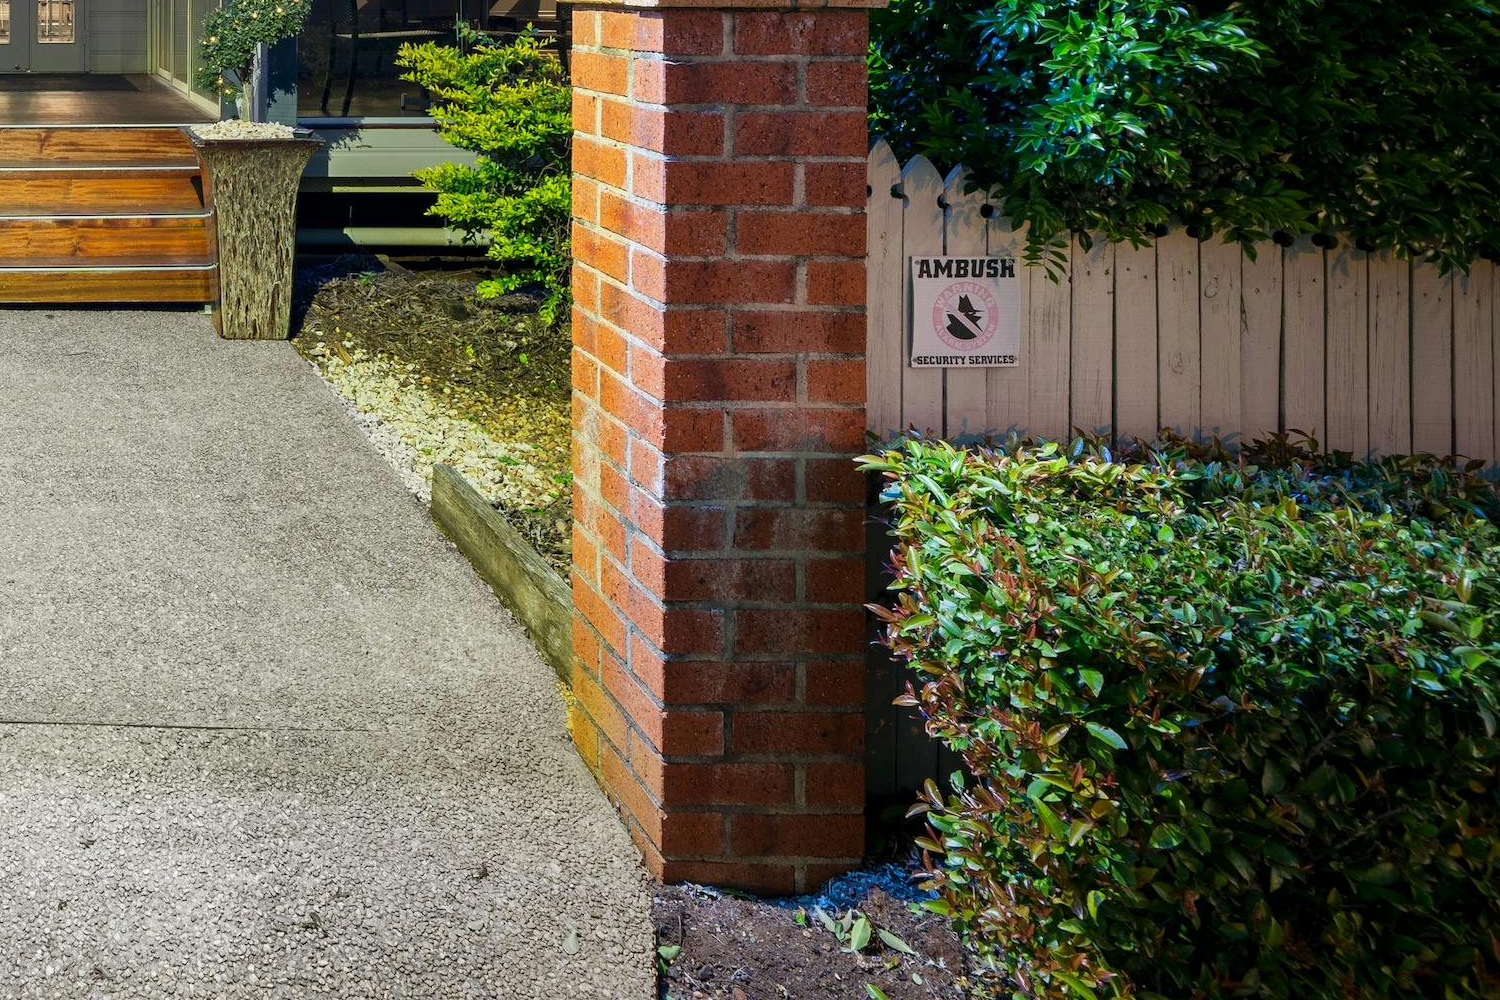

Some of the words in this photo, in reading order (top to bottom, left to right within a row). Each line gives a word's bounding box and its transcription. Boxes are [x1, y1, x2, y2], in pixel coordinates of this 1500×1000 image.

[918, 259, 1015, 278] AMBUSH
[936, 283, 994, 307] WARNING
[917, 356, 966, 365] SECURITY
[968, 355, 1015, 365] SERVICES
